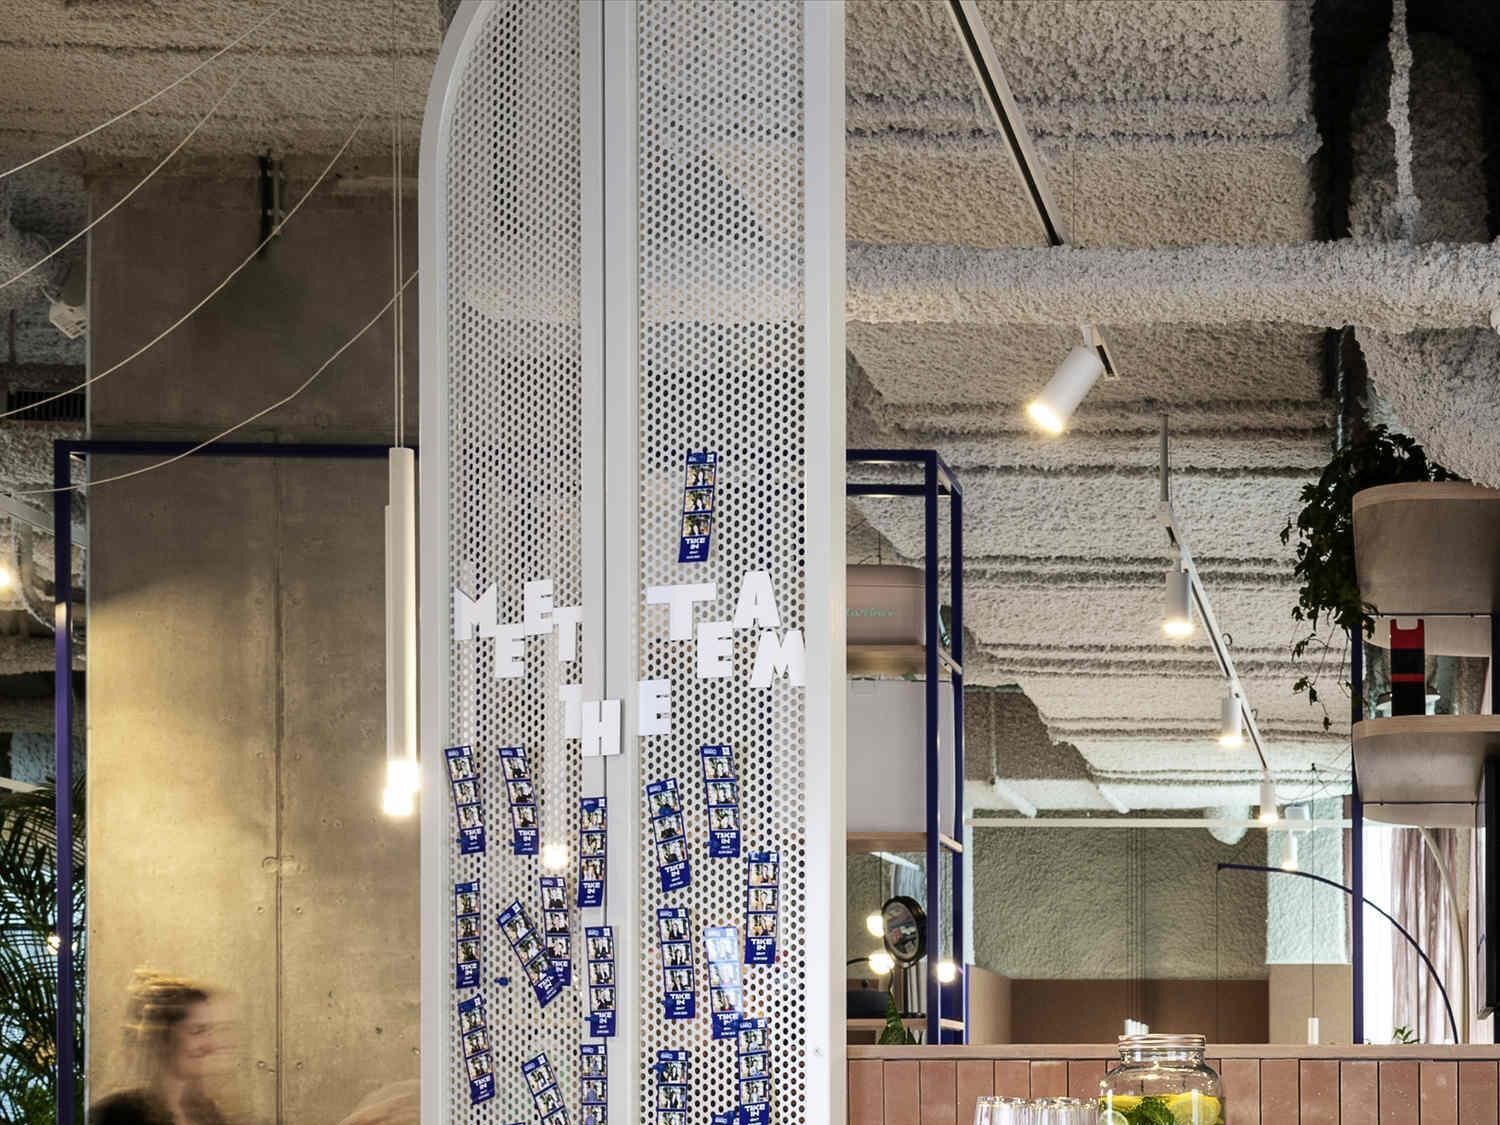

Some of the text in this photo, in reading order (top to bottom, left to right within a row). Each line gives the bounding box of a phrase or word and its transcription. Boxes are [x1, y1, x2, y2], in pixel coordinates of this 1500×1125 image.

[453, 570, 808, 757] MEET THE TEAM
